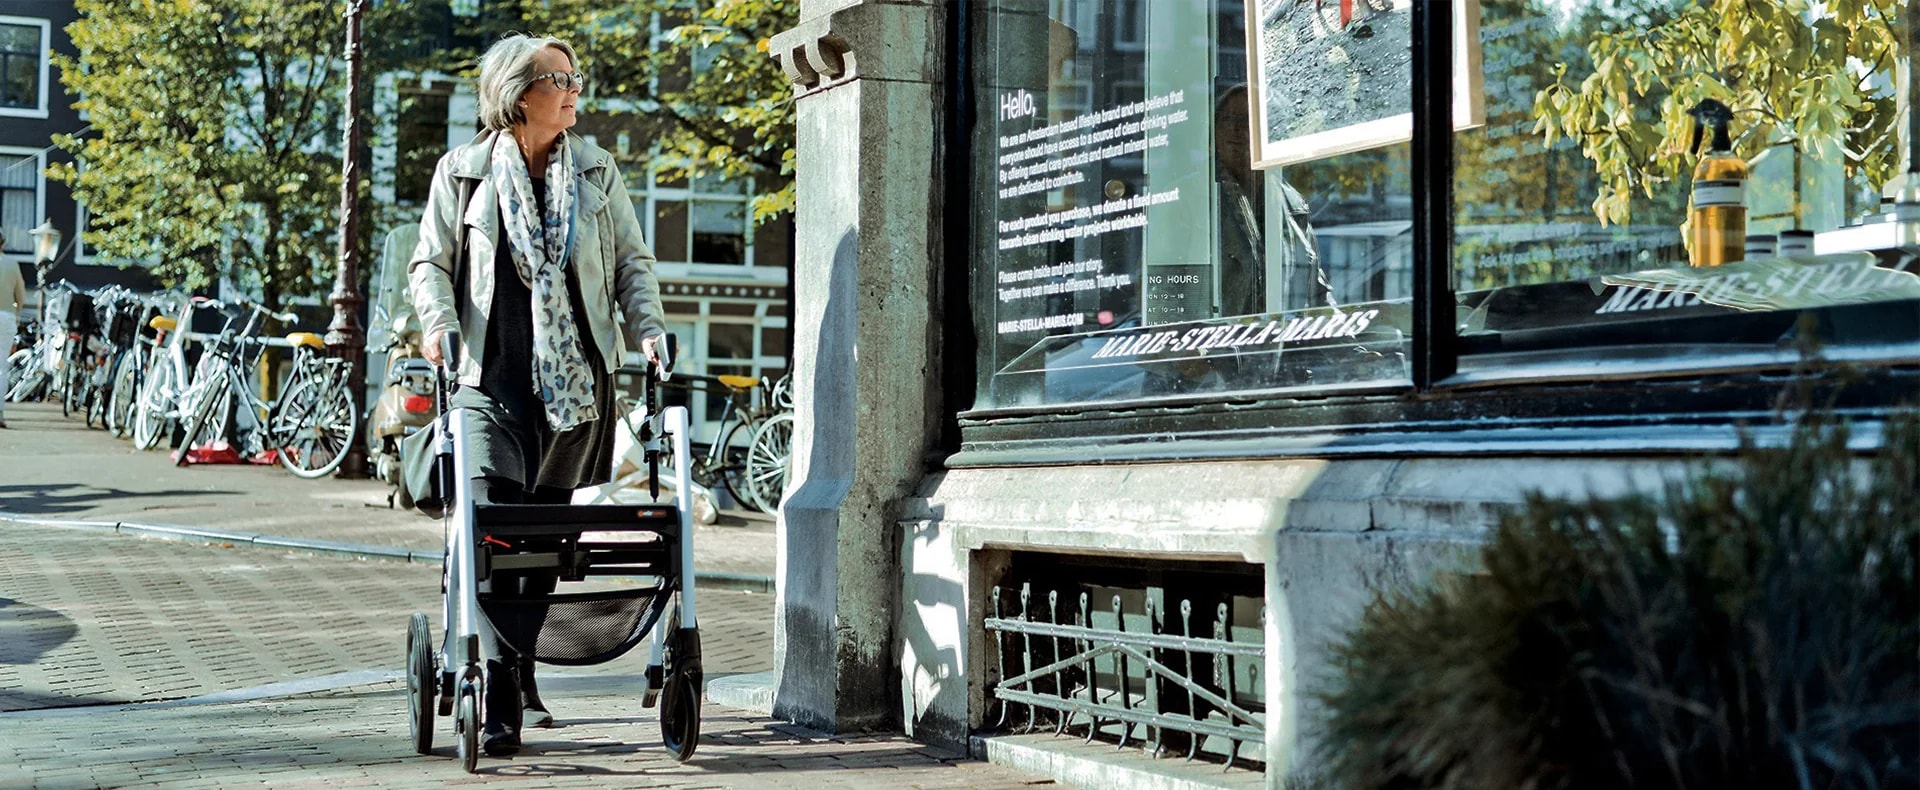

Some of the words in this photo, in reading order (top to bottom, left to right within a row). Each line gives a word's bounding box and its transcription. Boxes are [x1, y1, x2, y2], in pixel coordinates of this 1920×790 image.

[1000, 88, 1036, 122] Hello,
[1000, 135, 1009, 148] We
[1009, 135, 1018, 146] are
[1019, 132, 1027, 144] an
[1027, 124, 1059, 141] Amsterdam
[1059, 116, 1078, 133] based
[1078, 111, 1101, 128] lifestyle
[1101, 104, 1120, 123] brand
[1121, 101, 1134, 118] and
[1134, 101, 1144, 114] we
[1145, 95, 1169, 112] believe
[1169, 88, 1184, 105] that
[1000, 151, 1024, 166] everyone
[1024, 143, 1043, 159] should
[1044, 142, 1058, 154] have
[1059, 136, 1079, 151] access
[1080, 133, 1087, 146] to
[1087, 133, 1092, 144] a
[1093, 128, 1114, 143] source
[1114, 123, 1122, 138] of
[1122, 121, 1140, 136] clean
[1140, 114, 1167, 131] drinking
[1167, 108, 1189, 124] water.
[1000, 169, 1008, 184] By
[1008, 165, 1029, 180] offering
[1029, 160, 1048, 176] natural
[1048, 159, 1062, 171] care
[1062, 150, 1088, 171] products
[1088, 147, 1101, 162] and
[1102, 141, 1124, 159] natural
[1124, 137, 1148, 154] mineral
[1000, 188, 1008, 199] we
[1008, 186, 1018, 197] are
[1018, 177, 1046, 195] dedicated
[1046, 177, 1053, 189] to
[1053, 170, 1085, 188] contribute.
[999, 220, 1009, 233] For
[1010, 216, 1024, 230] each
[1025, 212, 1048, 230] product
[1048, 212, 1060, 226] you
[1060, 206, 1092, 224] purchase,
[1092, 204, 1103, 216] we
[1103, 198, 1127, 213] donate
[1127, 198, 1133, 209] a
[1133, 192, 1151, 208] fixed
[1151, 186, 1180, 205] amount
[999, 234, 1023, 250] towards
[1023, 233, 1039, 246] clean
[1039, 228, 1065, 243] drinking
[1065, 224, 1083, 239] water
[1083, 219, 1111, 239] projects
[1111, 212, 1148, 231] worldwide.
[998, 270, 1016, 284] Please
[1017, 269, 1033, 281] come
[1033, 264, 1050, 278] inside
[1051, 261, 1063, 276] and
[1062, 260, 1074, 277] join
[1074, 262, 1086, 273] our
[1086, 258, 1103, 273] story.
[998, 286, 1022, 303] Together
[1022, 287, 1031, 298] we
[1031, 285, 1042, 297] can
[1043, 281, 1059, 295] make
[1059, 282, 1065, 293] a
[1065, 278, 1096, 293] difference.
[1096, 272, 1116, 289] Thank
[1116, 274, 1132, 290] you.
[1166, 274, 1200, 284] HOURS
[997, 312, 1085, 334] MARIE-STELLA-MARIS.COM
[1092, 309, 1379, 359] MARIE-STELLA-MARIS
